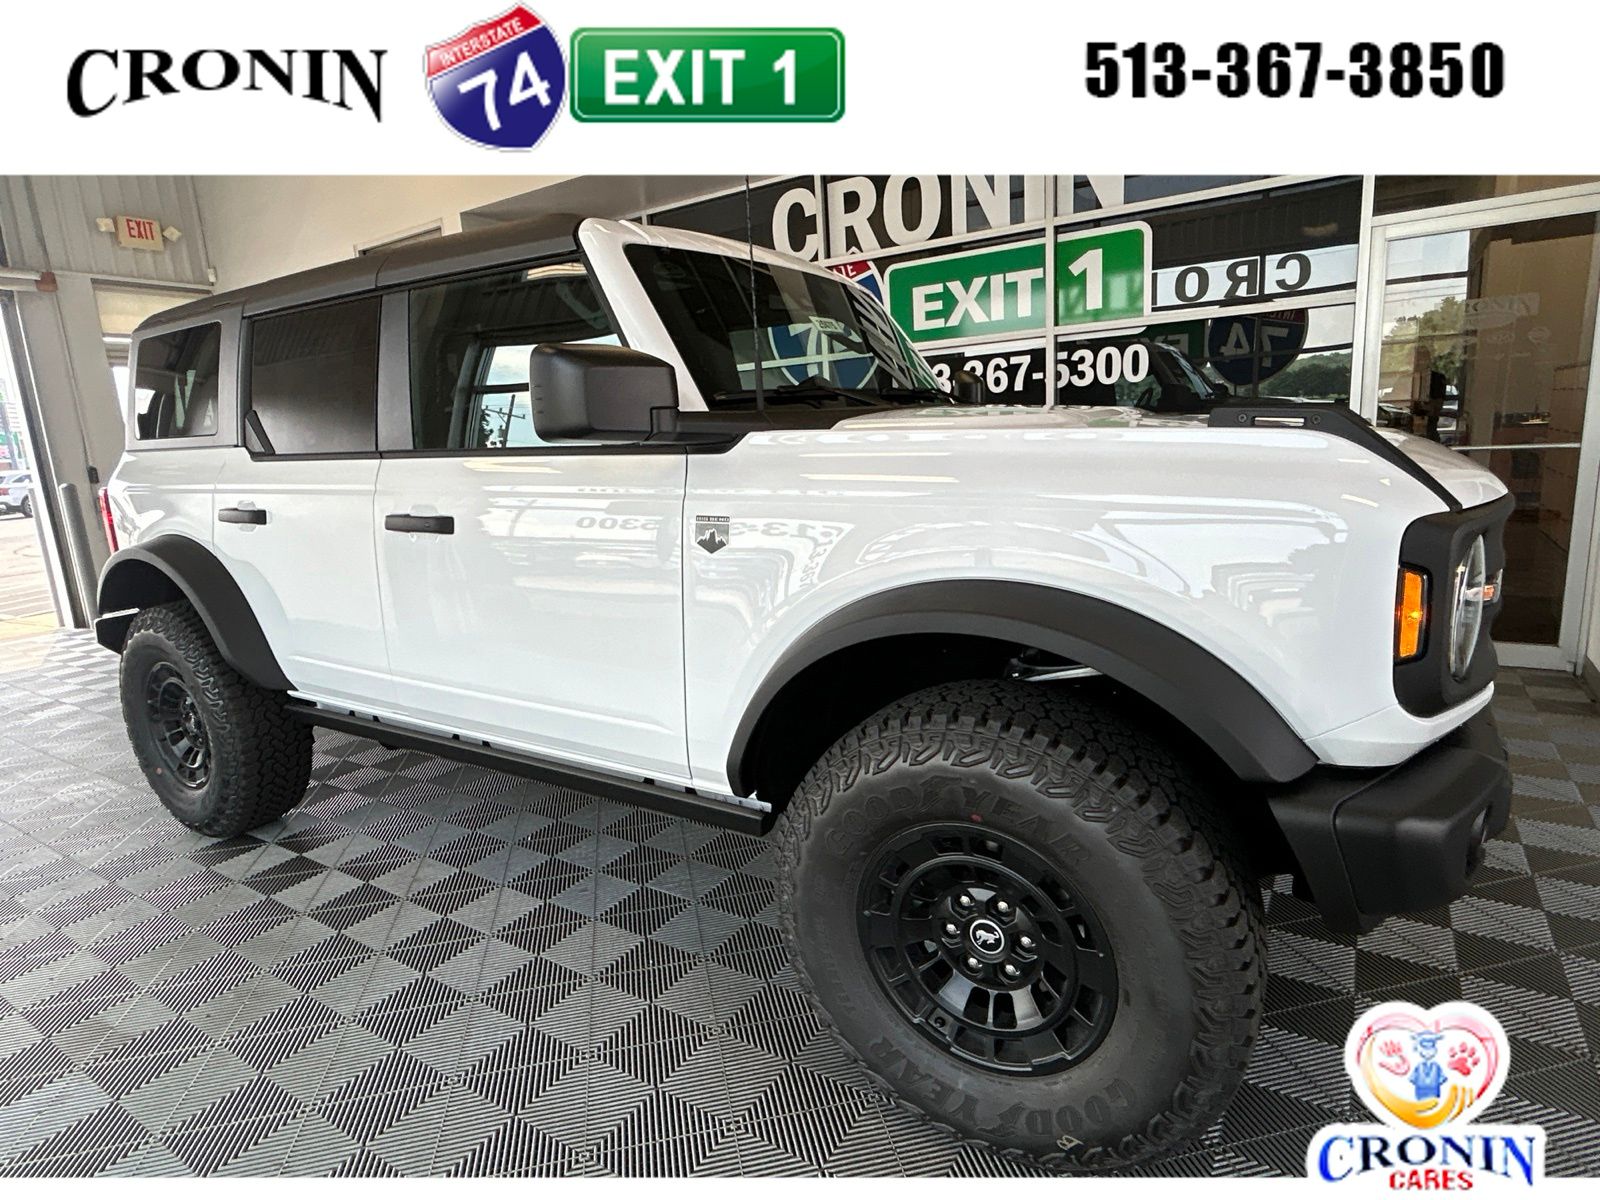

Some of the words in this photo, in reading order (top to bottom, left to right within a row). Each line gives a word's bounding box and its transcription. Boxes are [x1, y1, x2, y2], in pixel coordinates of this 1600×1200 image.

[126, 217, 156, 241] EXIT
[771, 174, 1126, 263] CRONIN
[912, 267, 1044, 332] EXIT
[1068, 247, 1104, 311] 1
